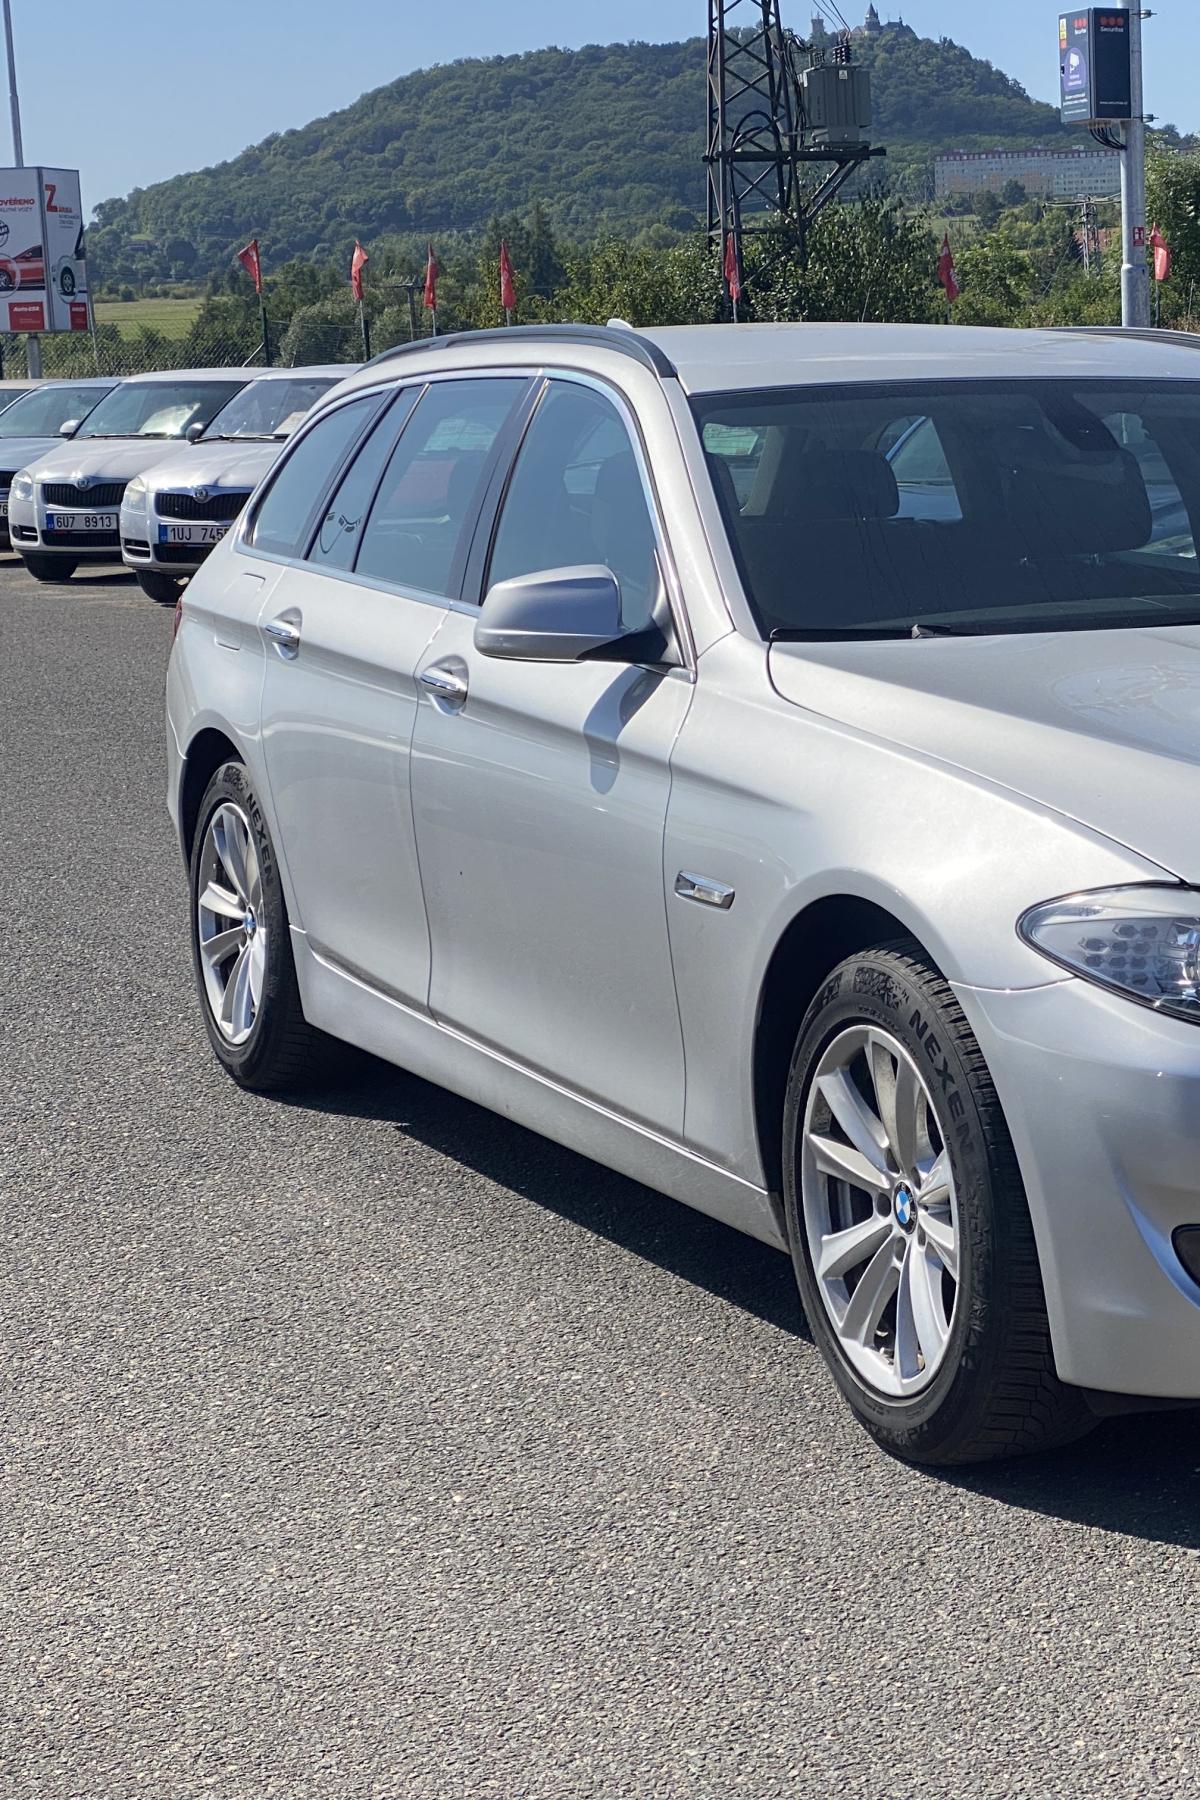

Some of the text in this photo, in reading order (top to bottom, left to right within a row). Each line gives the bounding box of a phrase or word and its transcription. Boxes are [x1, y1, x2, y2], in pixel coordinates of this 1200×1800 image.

[56, 516, 112, 528] 6U7 8913
[170, 528, 191, 540] 1UJ
[247, 793, 273, 887] NEXEN
[909, 1009, 975, 1152] NEXEN
